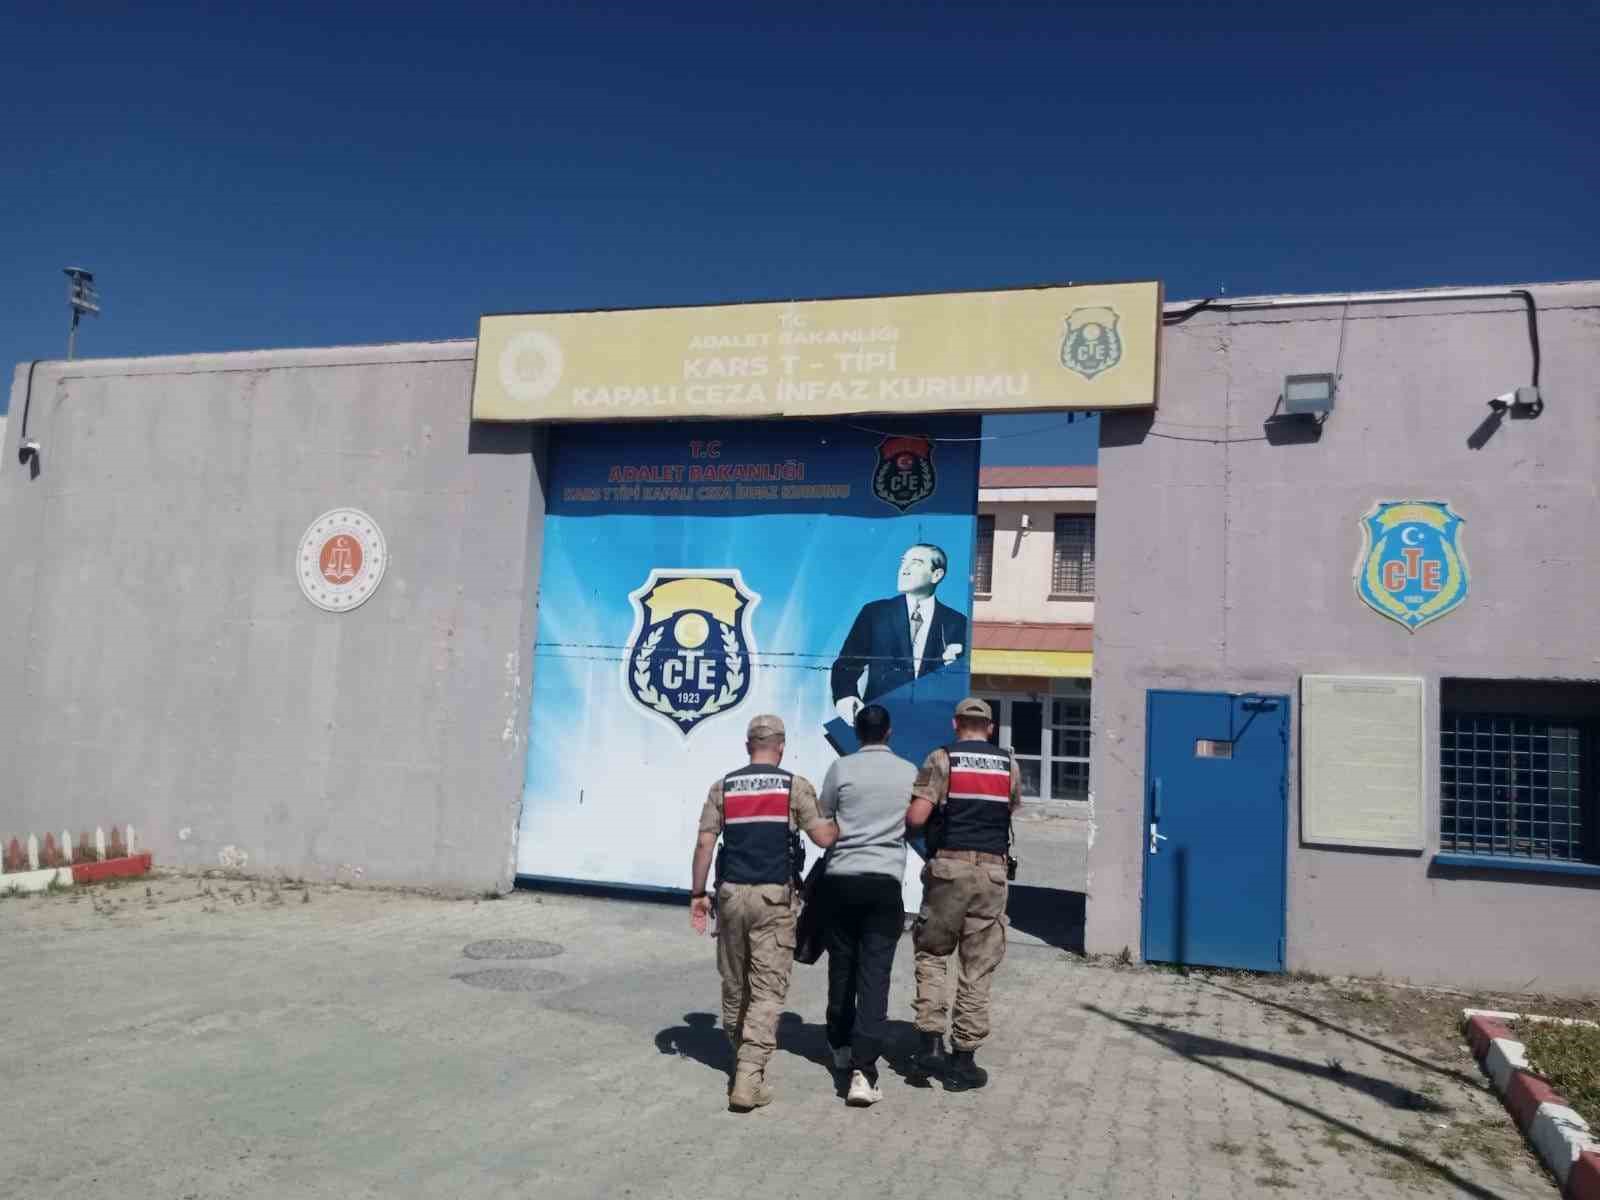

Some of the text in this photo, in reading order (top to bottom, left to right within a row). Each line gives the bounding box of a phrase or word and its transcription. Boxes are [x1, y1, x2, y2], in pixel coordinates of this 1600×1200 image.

[687, 333, 769, 351] ADALET
[1078, 341, 1105, 361] CTE
[683, 357, 769, 379] KARS
[779, 354, 800, 375] T
[834, 344, 896, 373] TİPİ
[572, 372, 1028, 407] KAPALI CEZA İNFAZ KURUMU
[607, 464, 685, 483] ADALET
[891, 471, 919, 491] CTE
[1382, 547, 1441, 592] CTE
[662, 648, 716, 690] CTE
[677, 692, 700, 704] 1923
